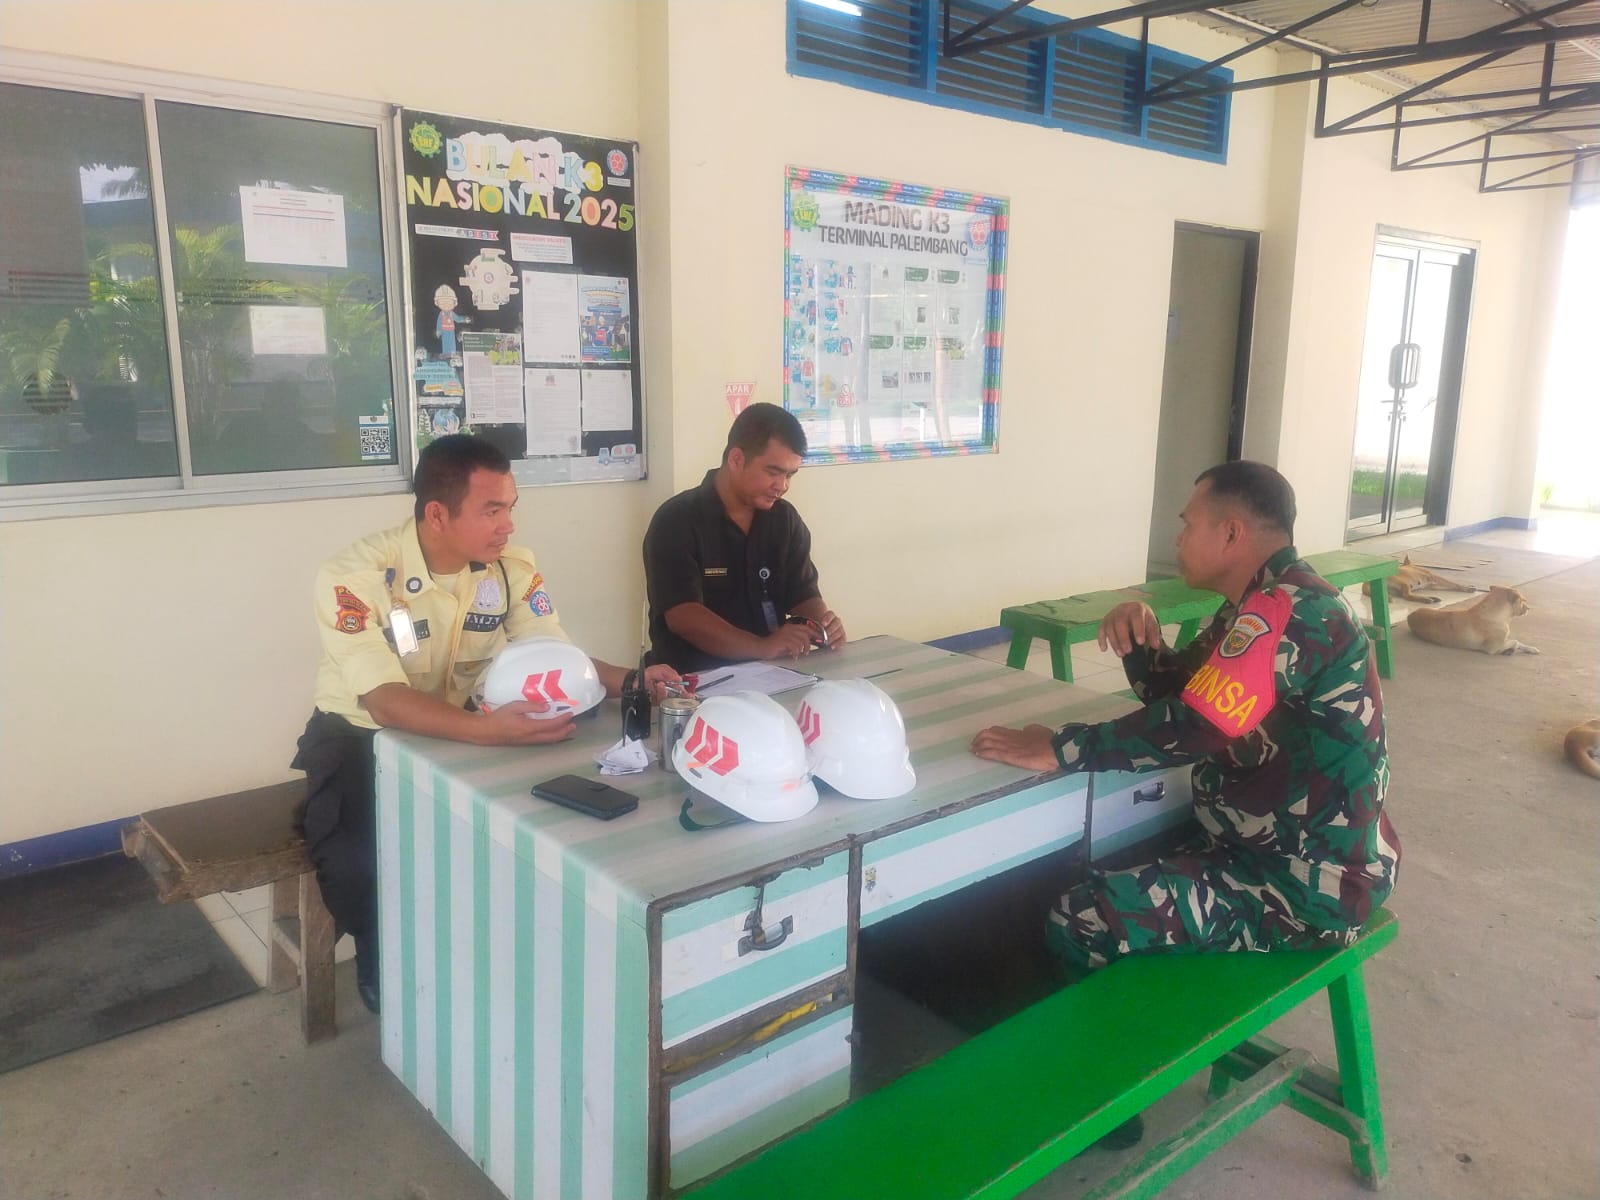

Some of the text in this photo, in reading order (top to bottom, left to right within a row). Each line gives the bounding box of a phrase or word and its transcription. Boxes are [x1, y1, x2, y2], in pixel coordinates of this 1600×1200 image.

[446, 138, 603, 192] BULAN K3
[405, 175, 635, 231] NASIONAL 2025
[845, 200, 950, 234] MADING K3
[818, 225, 969, 256] TERMINAL PALEMBANG
